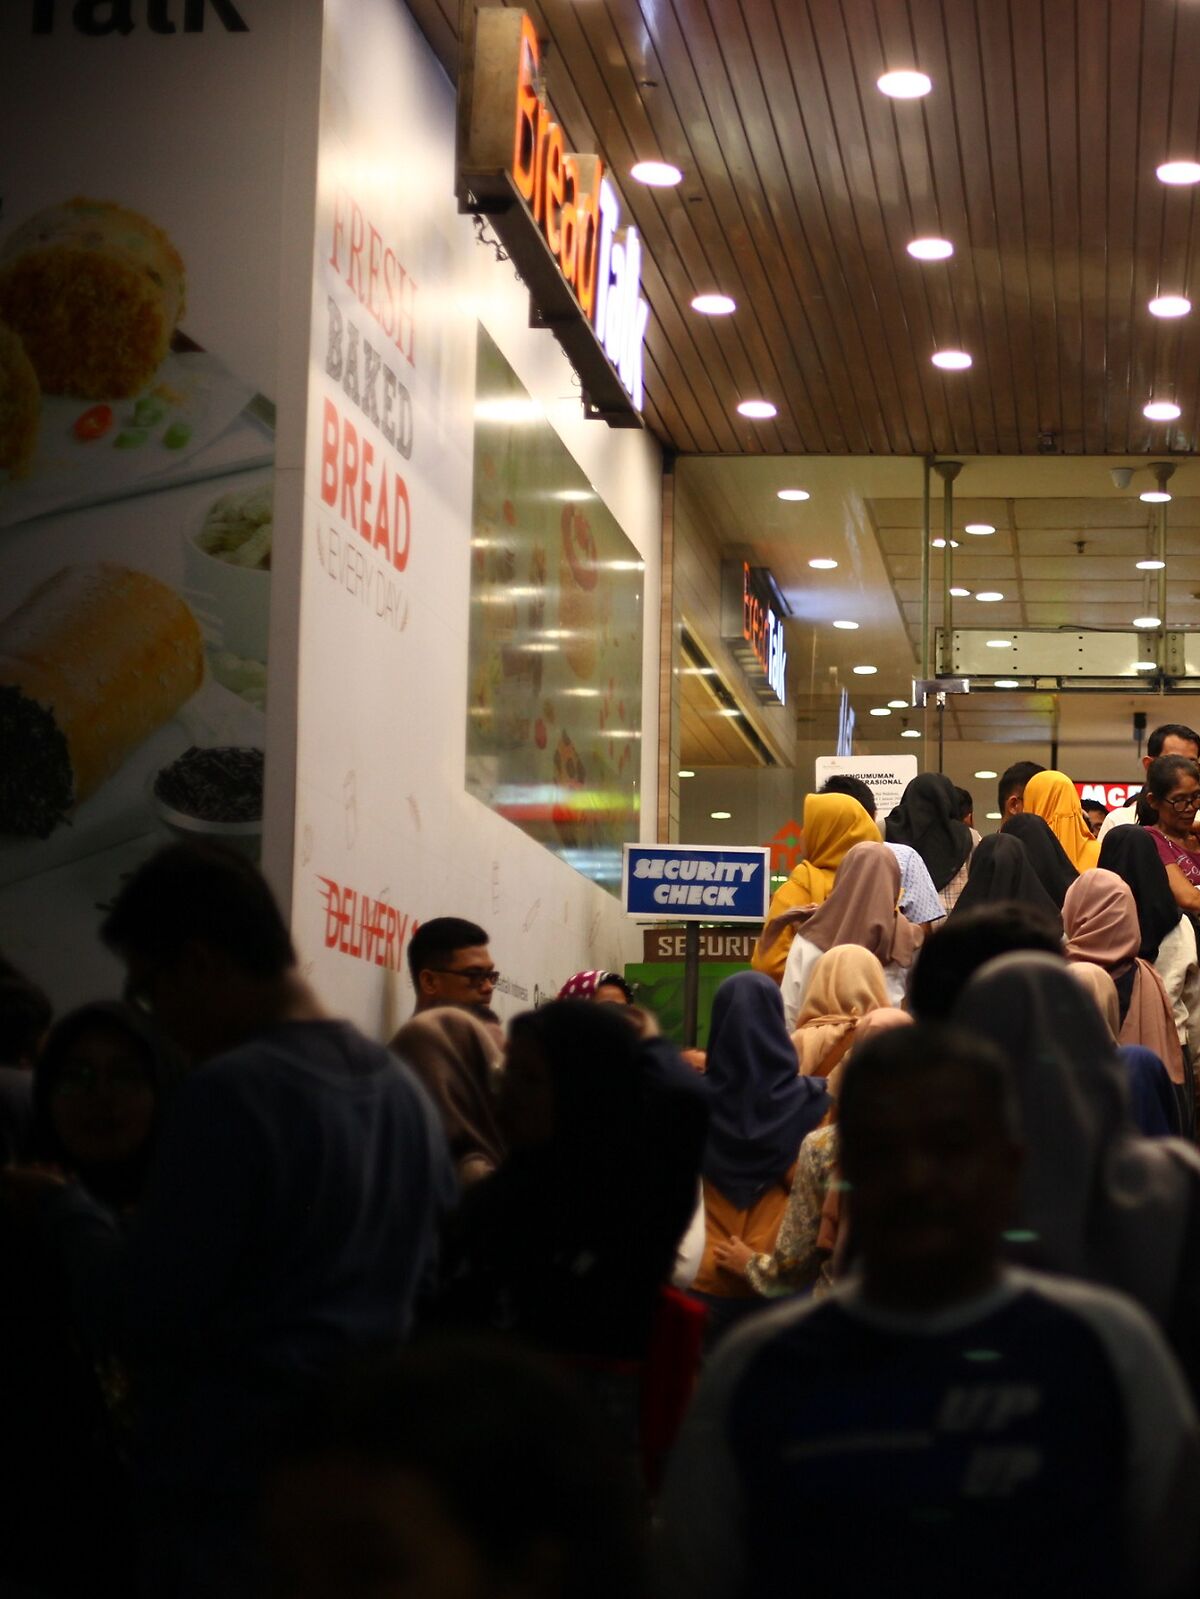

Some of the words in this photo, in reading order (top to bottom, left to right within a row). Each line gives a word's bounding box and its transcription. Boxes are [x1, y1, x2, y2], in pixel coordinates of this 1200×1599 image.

[329, 192, 418, 368] FRESH
[325, 294, 414, 461] BAKED
[320, 395, 412, 573] BREAD
[316, 874, 409, 972] DELIVERY
[633, 858, 760, 883] SECURITY
[653, 884, 739, 907] CHECK
